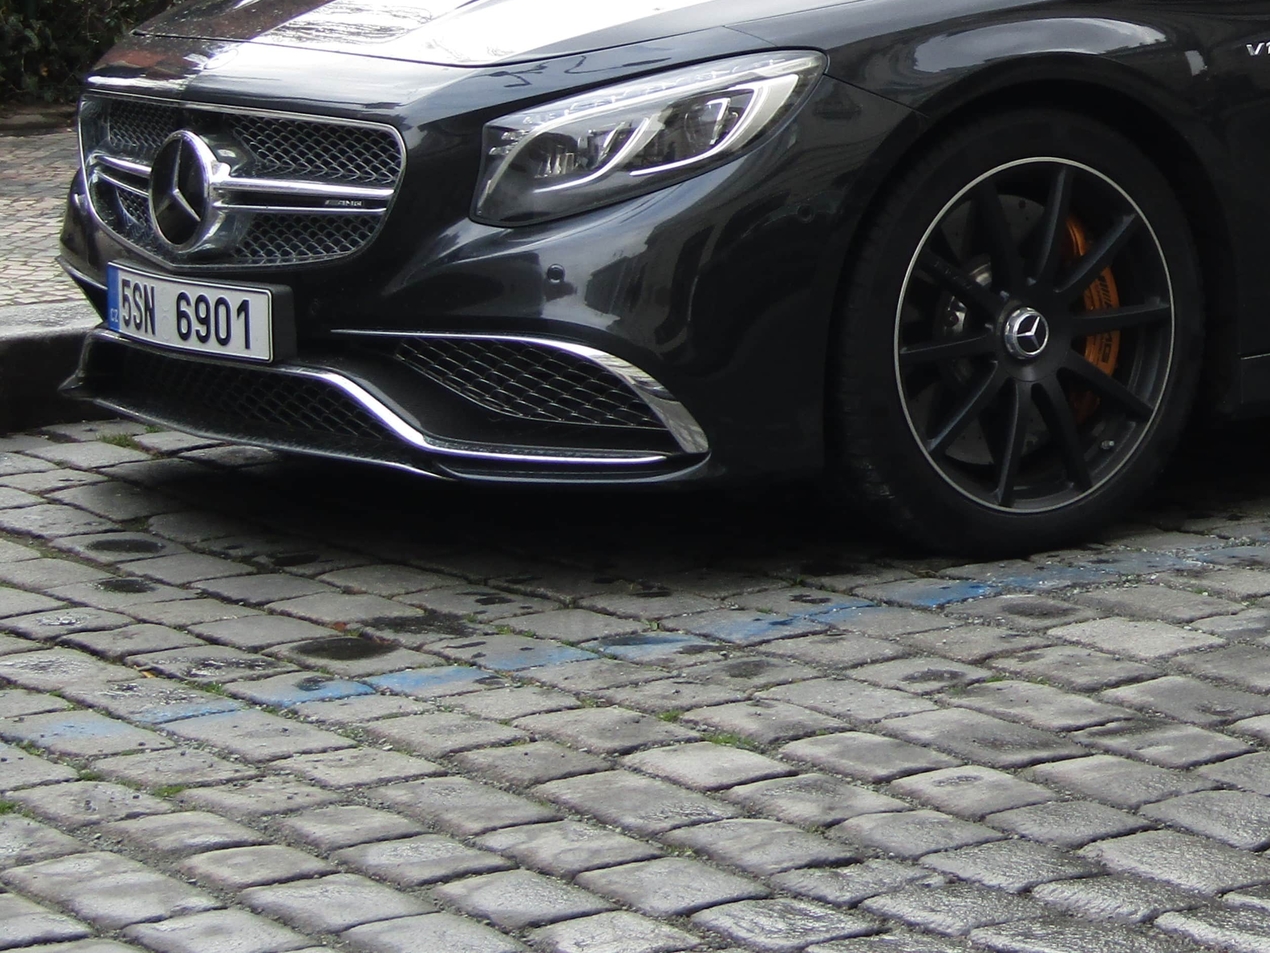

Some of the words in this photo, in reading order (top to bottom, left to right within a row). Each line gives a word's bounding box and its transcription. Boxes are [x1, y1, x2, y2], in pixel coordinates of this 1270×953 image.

[110, 308, 119, 323] CZ
[121, 278, 156, 335] 5SN
[176, 291, 251, 350] 6901
